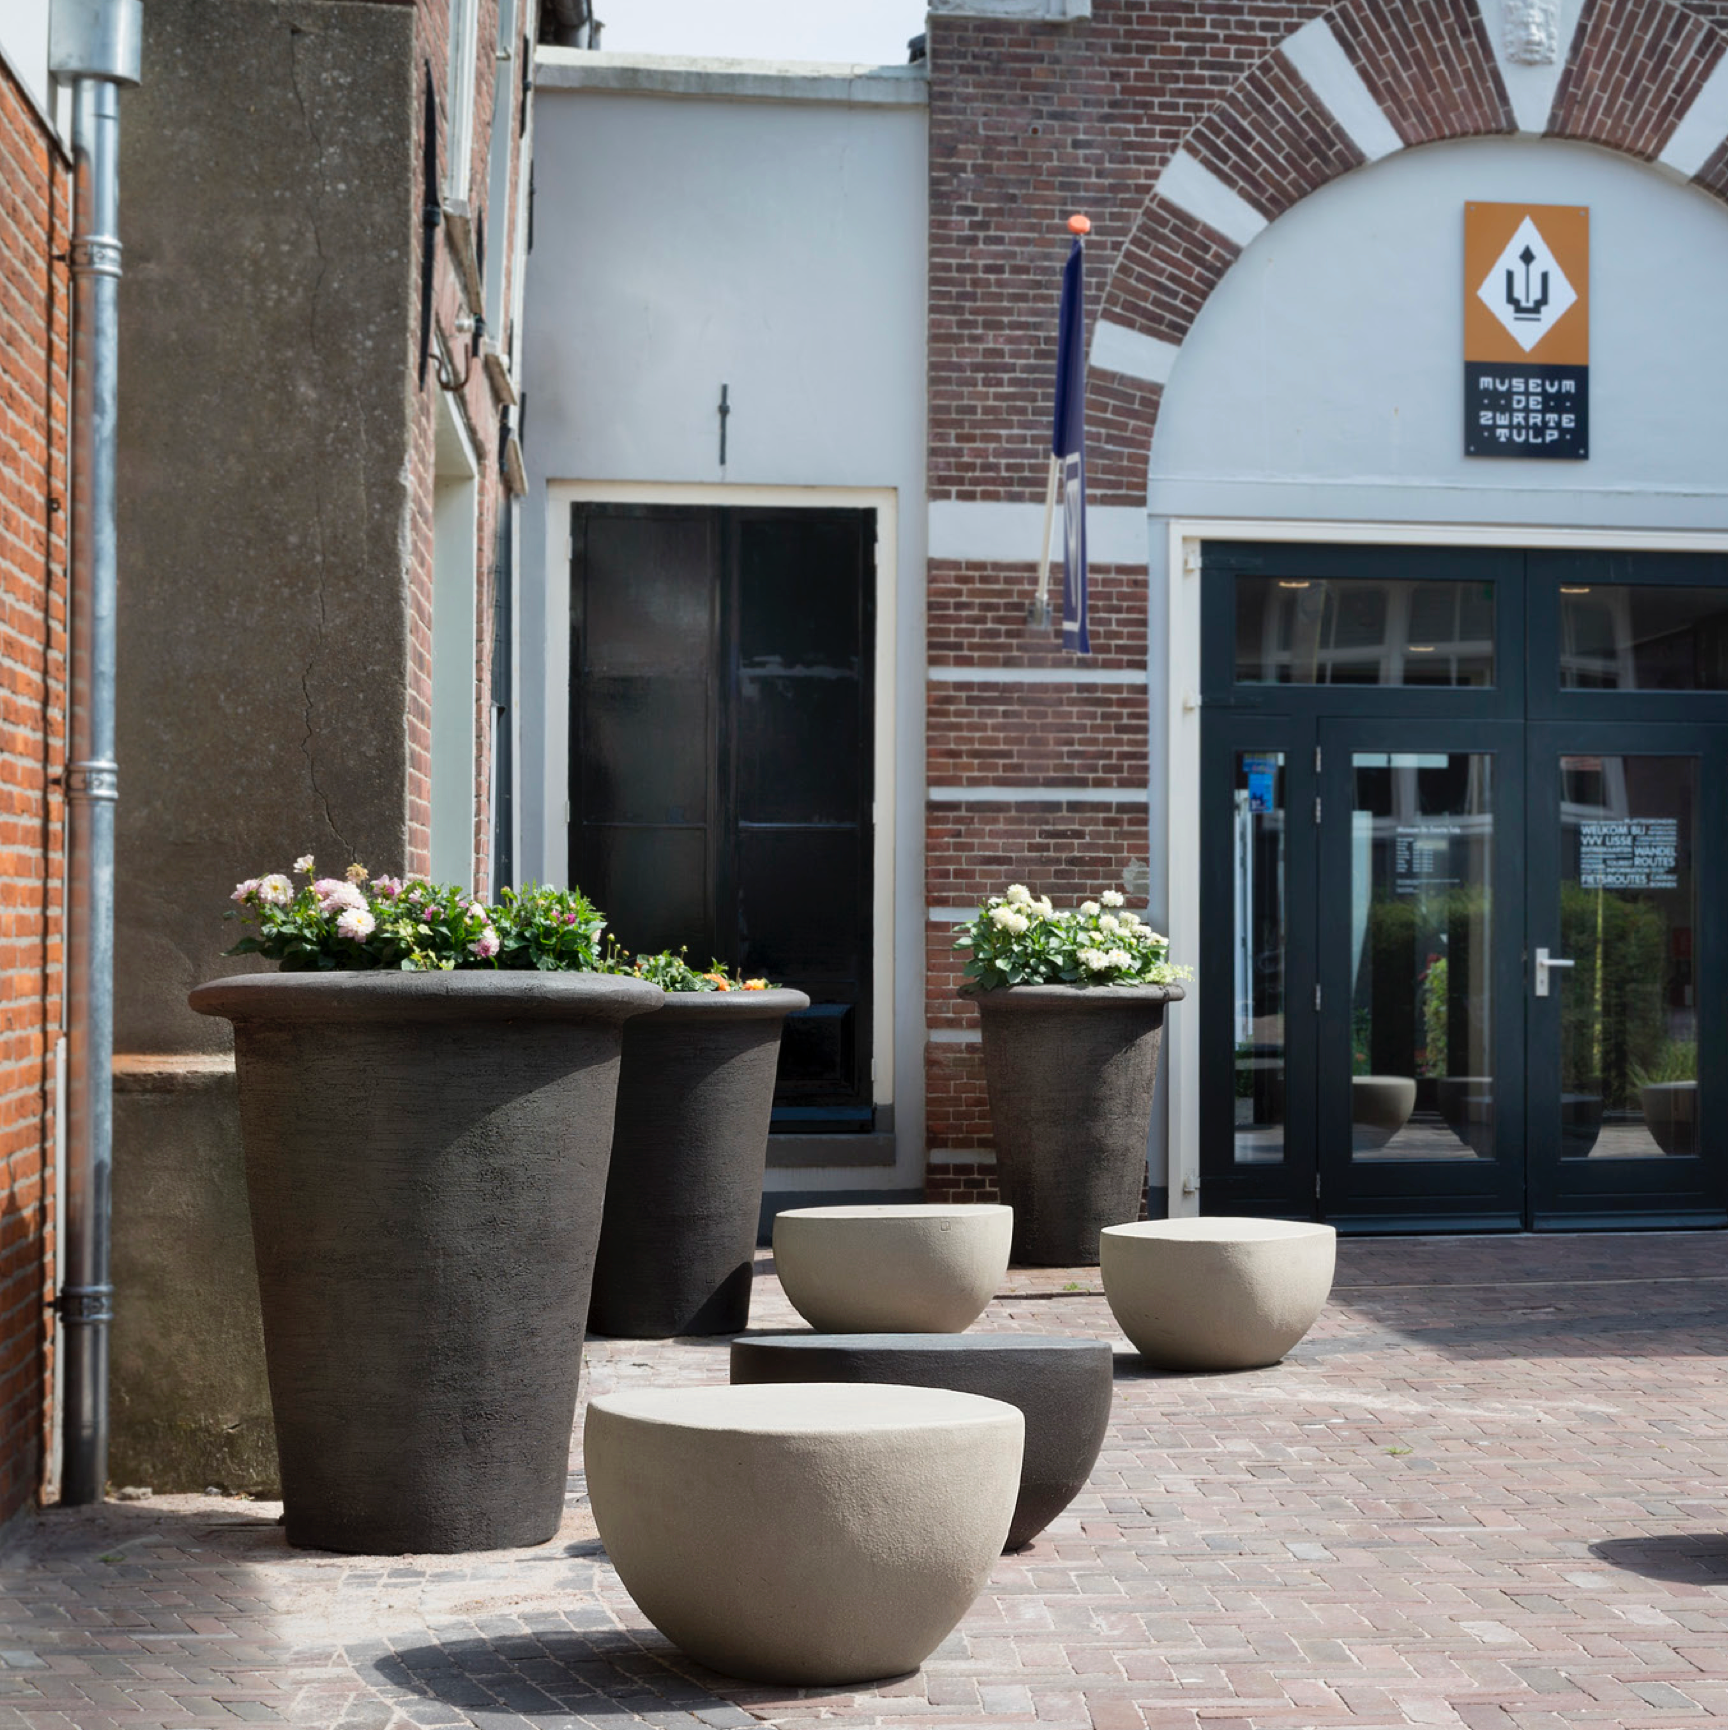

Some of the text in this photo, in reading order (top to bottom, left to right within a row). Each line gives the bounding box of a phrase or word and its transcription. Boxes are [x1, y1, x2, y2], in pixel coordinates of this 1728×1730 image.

[1479, 377, 1575, 393] MUSEUM
[1512, 395, 1542, 410] DE
[1479, 411, 1575, 428] ZWARTE
[1495, 428, 1559, 443] TULP
[1581, 825, 1628, 835] WELKOM
[1581, 835, 1632, 845] VVV LISSE
[1634, 846, 1676, 856] WANDEL
[1634, 857, 1675, 867] ROUTES
[1581, 874, 1648, 885] FIETSROUTES
